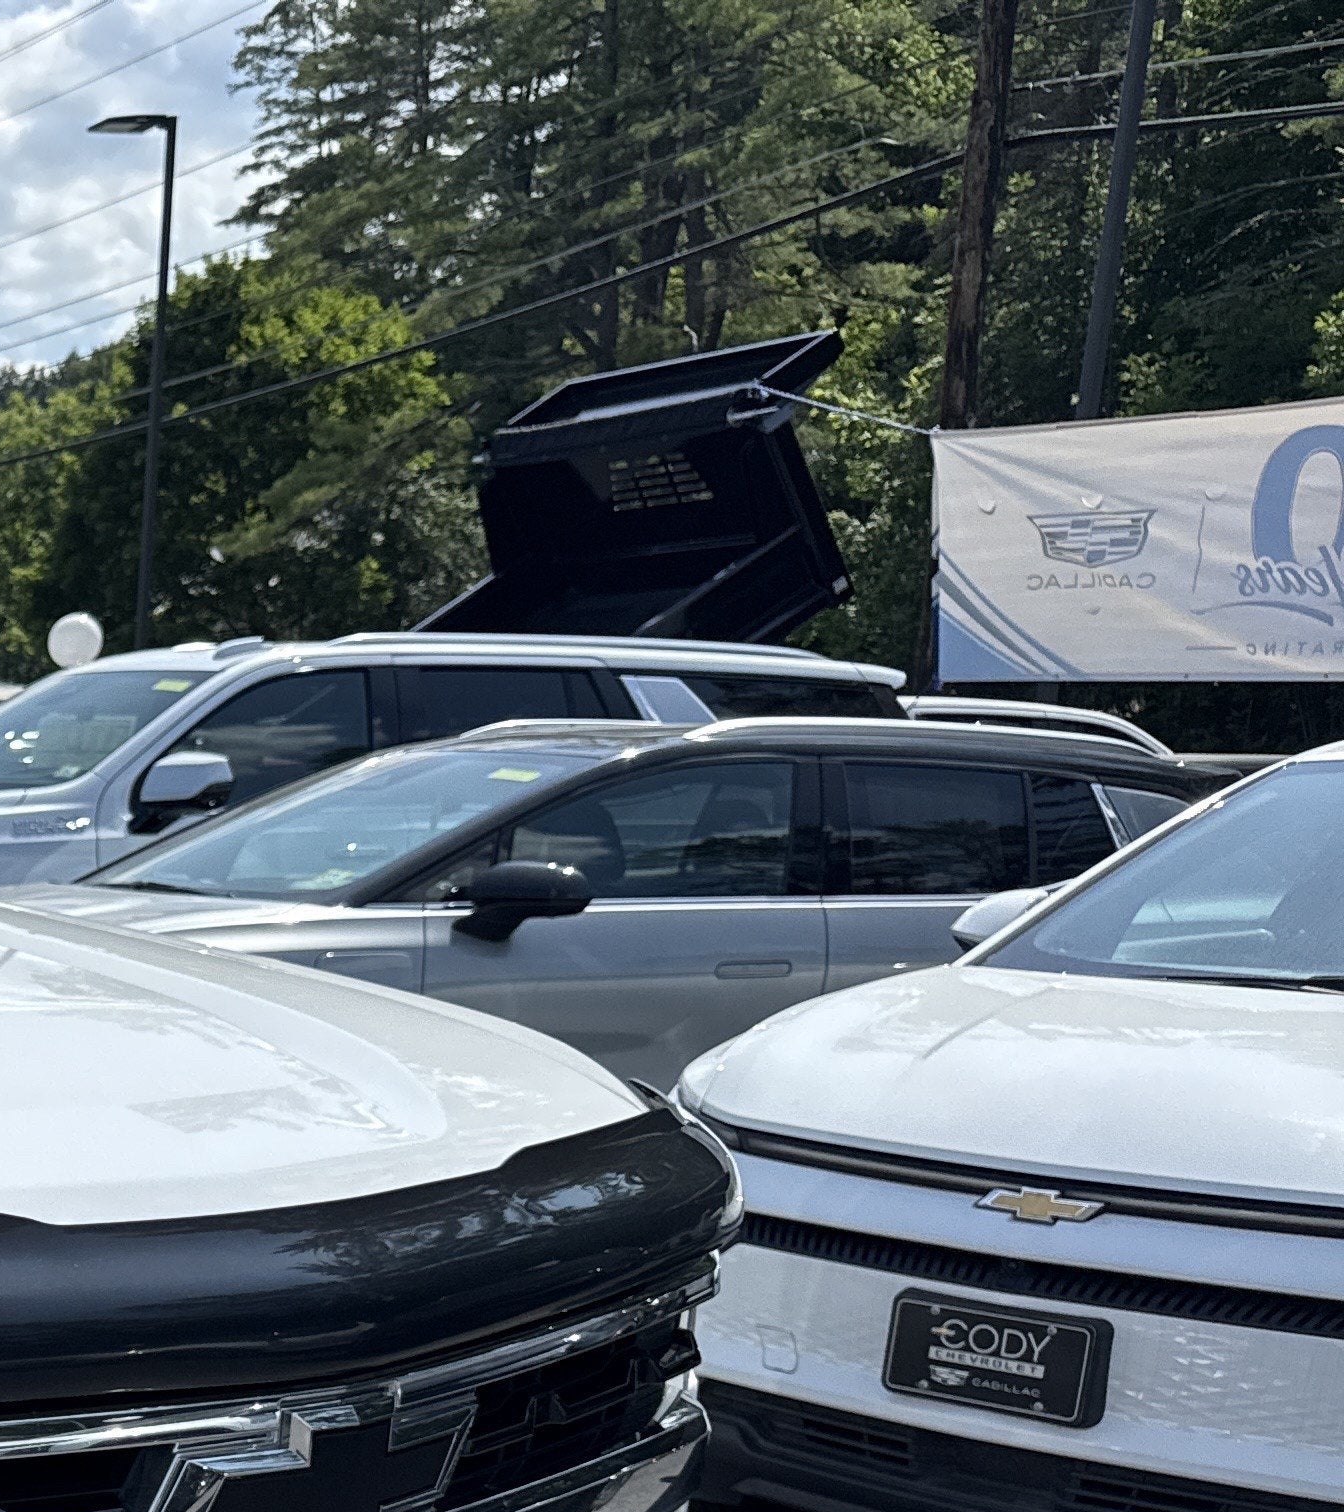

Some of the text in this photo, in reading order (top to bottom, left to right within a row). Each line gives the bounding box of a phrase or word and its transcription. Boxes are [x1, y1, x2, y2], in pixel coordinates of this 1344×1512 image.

[938, 1318, 1051, 1362] CODY
[934, 1349, 1038, 1374] CHEVROLET
[972, 1377, 1041, 1398] CADILLAC
